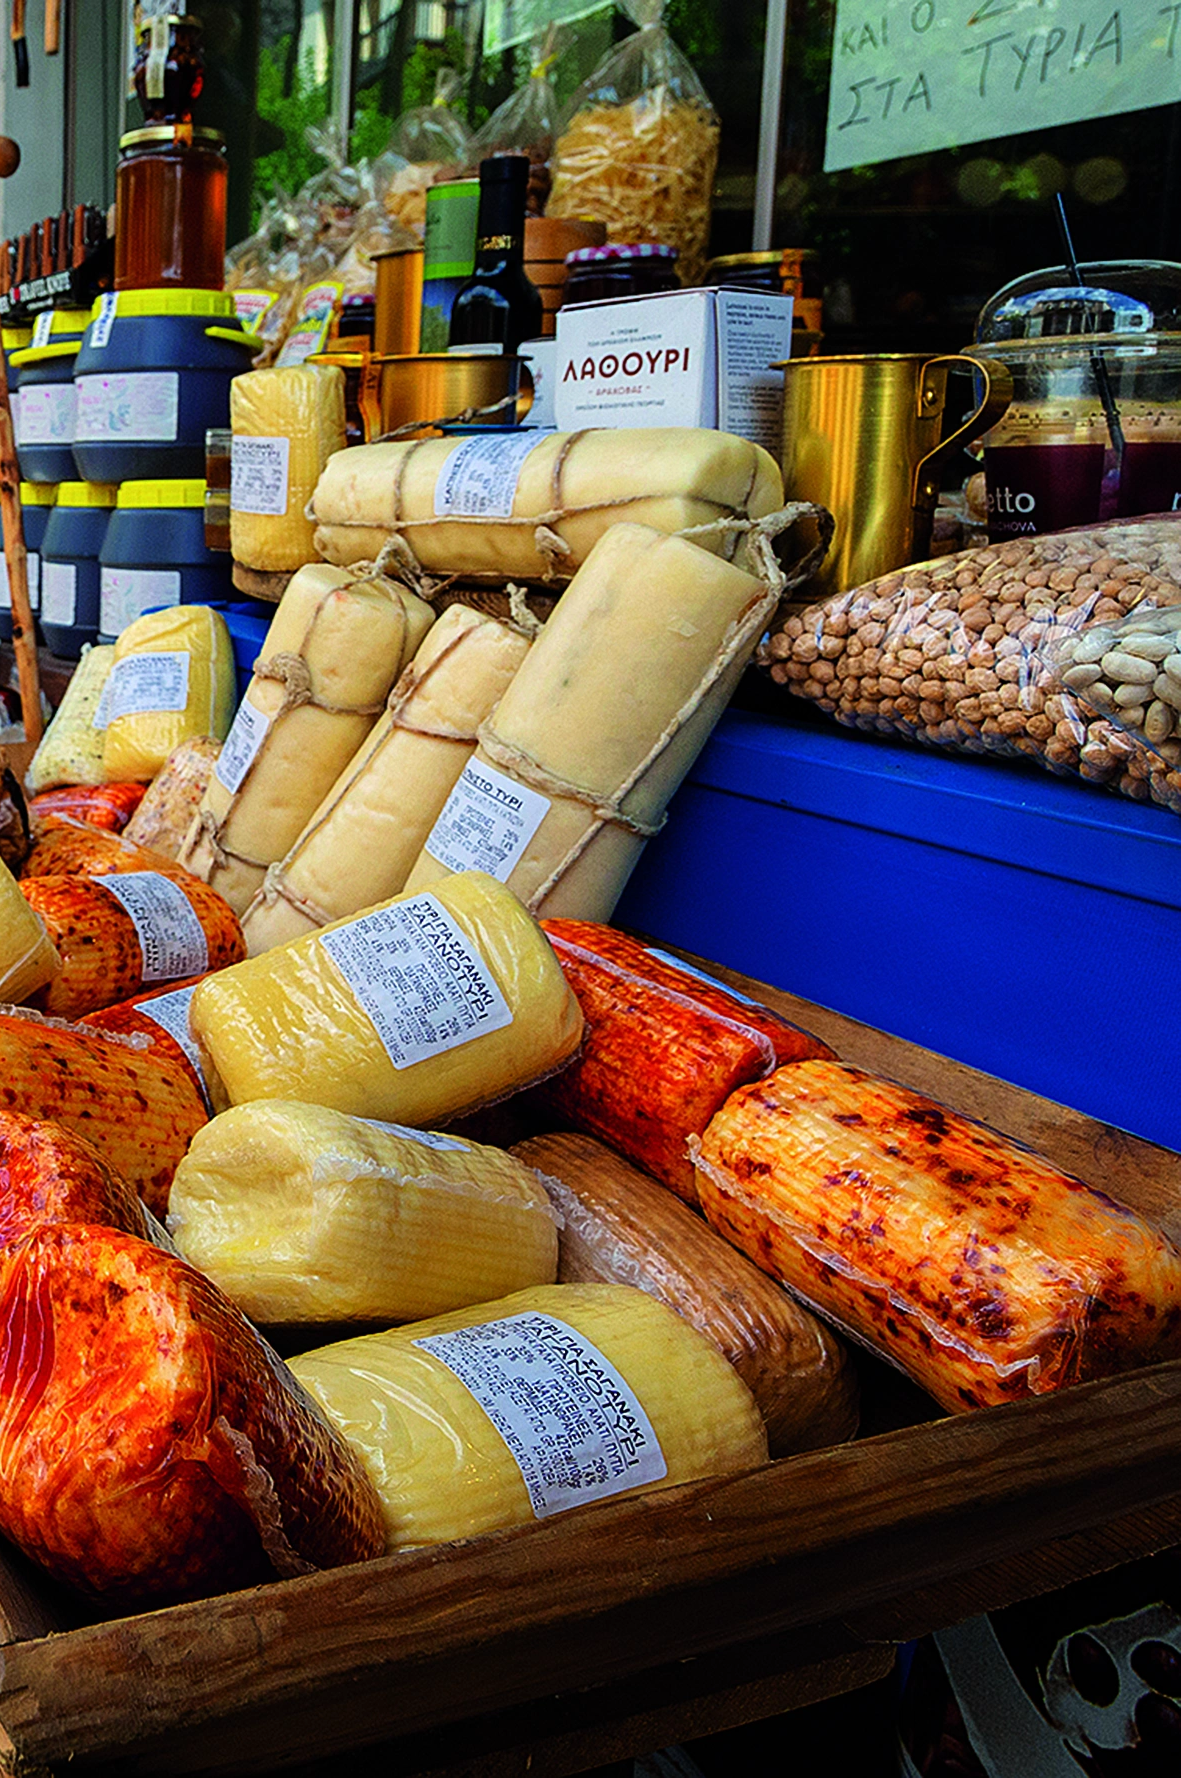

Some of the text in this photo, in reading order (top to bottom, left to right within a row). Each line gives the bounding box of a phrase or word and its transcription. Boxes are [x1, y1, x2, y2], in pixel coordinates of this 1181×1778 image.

[839, 16, 889, 55] ΚΑΙ
[838, 71, 932, 130] ΣΤΑ
[961, 11, 1122, 97] ΤΥΡΙΑ
[562, 347, 690, 383] ΛΑΘΟΥΡΙ
[496, 787, 523, 810] ΤΥΡΙ
[407, 904, 489, 1020] ΣΑΓΑΝΟΤΥΡΙ
[435, 922, 452, 941] ΓΙΑ
[449, 941, 493, 1004] ΣΑΓΑΝΑΚΙ
[546, 1379, 593, 1437] ΠΡΩΤΕΙΝΕΣ
[559, 1336, 583, 1357] ΓΙΑ
[582, 1359, 645, 1446] ΣΑΓΑΝΑΚΙ
[604, 1442, 624, 1476] ΠΥΤΙΑ
